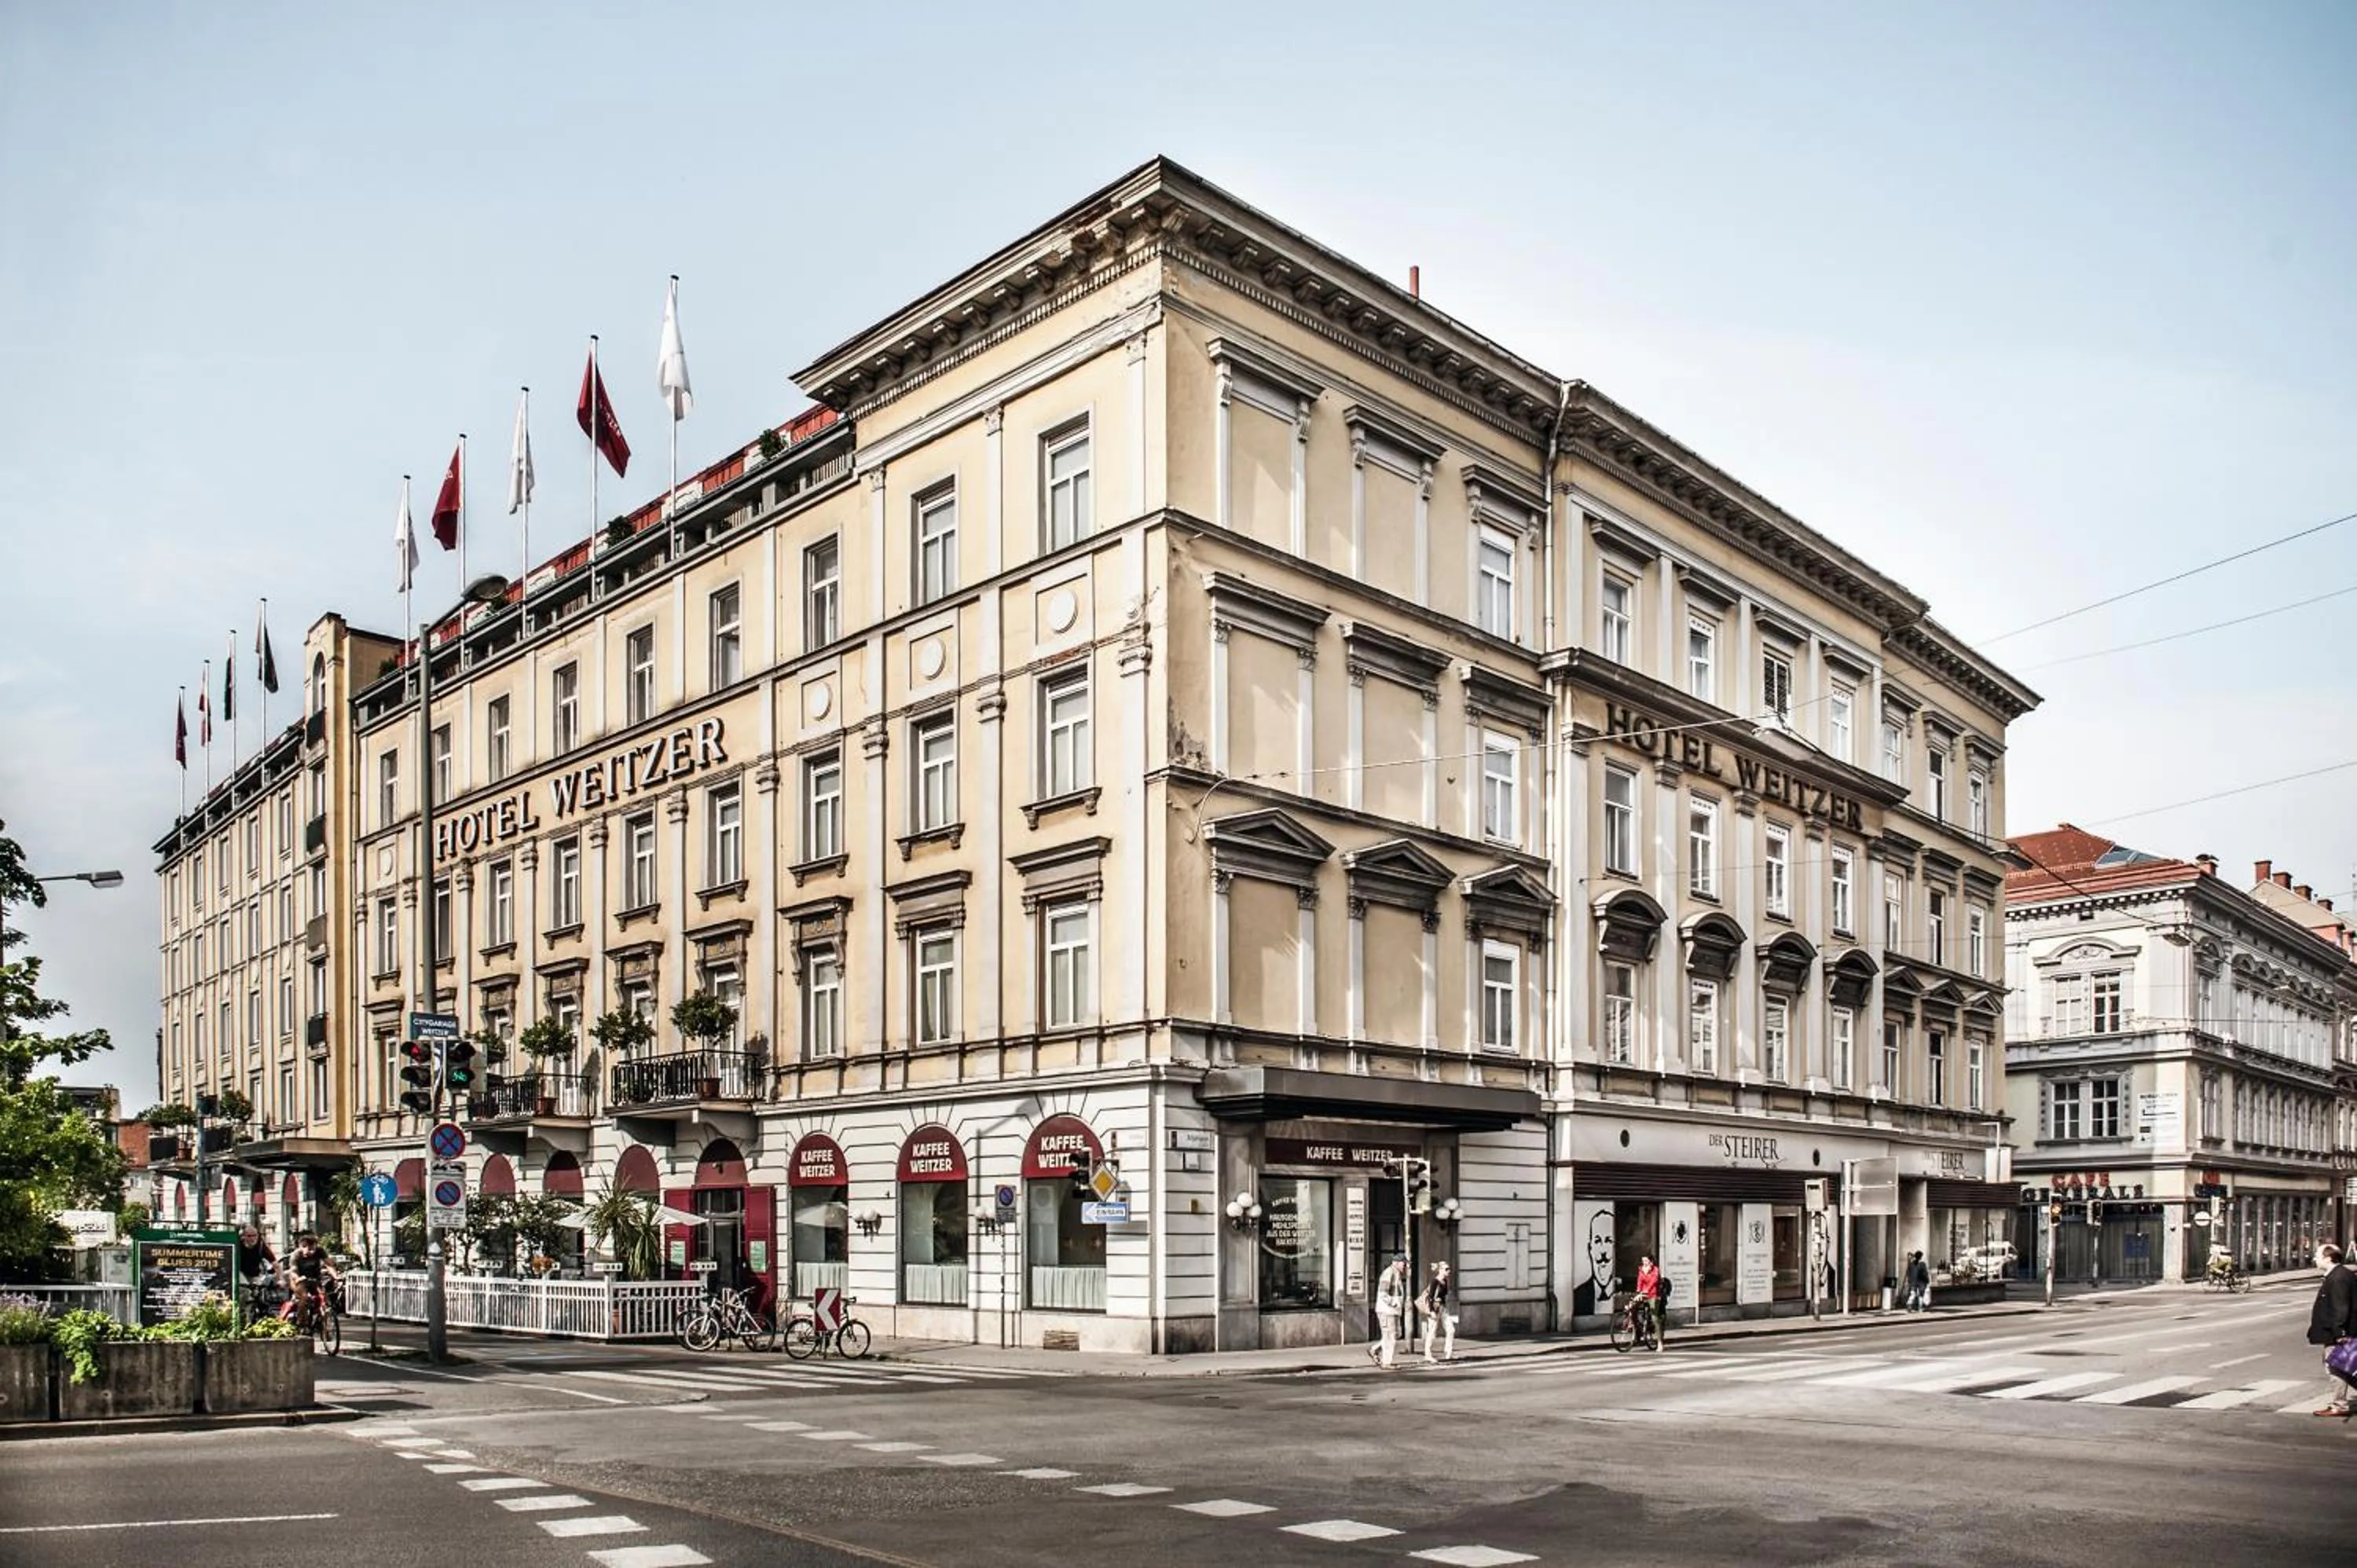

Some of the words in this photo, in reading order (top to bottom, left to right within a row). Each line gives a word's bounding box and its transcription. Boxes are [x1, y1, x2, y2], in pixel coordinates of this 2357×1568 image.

[1606, 703, 1723, 777] HOTEL
[1734, 754, 1864, 831] WEITZER
[435, 791, 540, 862] HOTEL
[549, 717, 728, 819] WEITZER
[912, 1141, 950, 1157] KAFFEE
[1041, 1135, 1083, 1151] KAFFEE
[1709, 1134, 1724, 1146] DER
[1725, 1135, 1780, 1163] STEIRER
[801, 1149, 834, 1163] KAFFEE
[1038, 1152, 1072, 1168] WEITZ
[1307, 1146, 1343, 1160] KAFFEE
[1351, 1149, 1393, 1162] WEITZER
[799, 1165, 835, 1178] WEITZER
[909, 1158, 952, 1173] WEITZER
[151, 1247, 225, 1258] SUMMERTIME
[157, 1258, 192, 1267] BLUES
[195, 1259, 218, 1268] 2013
